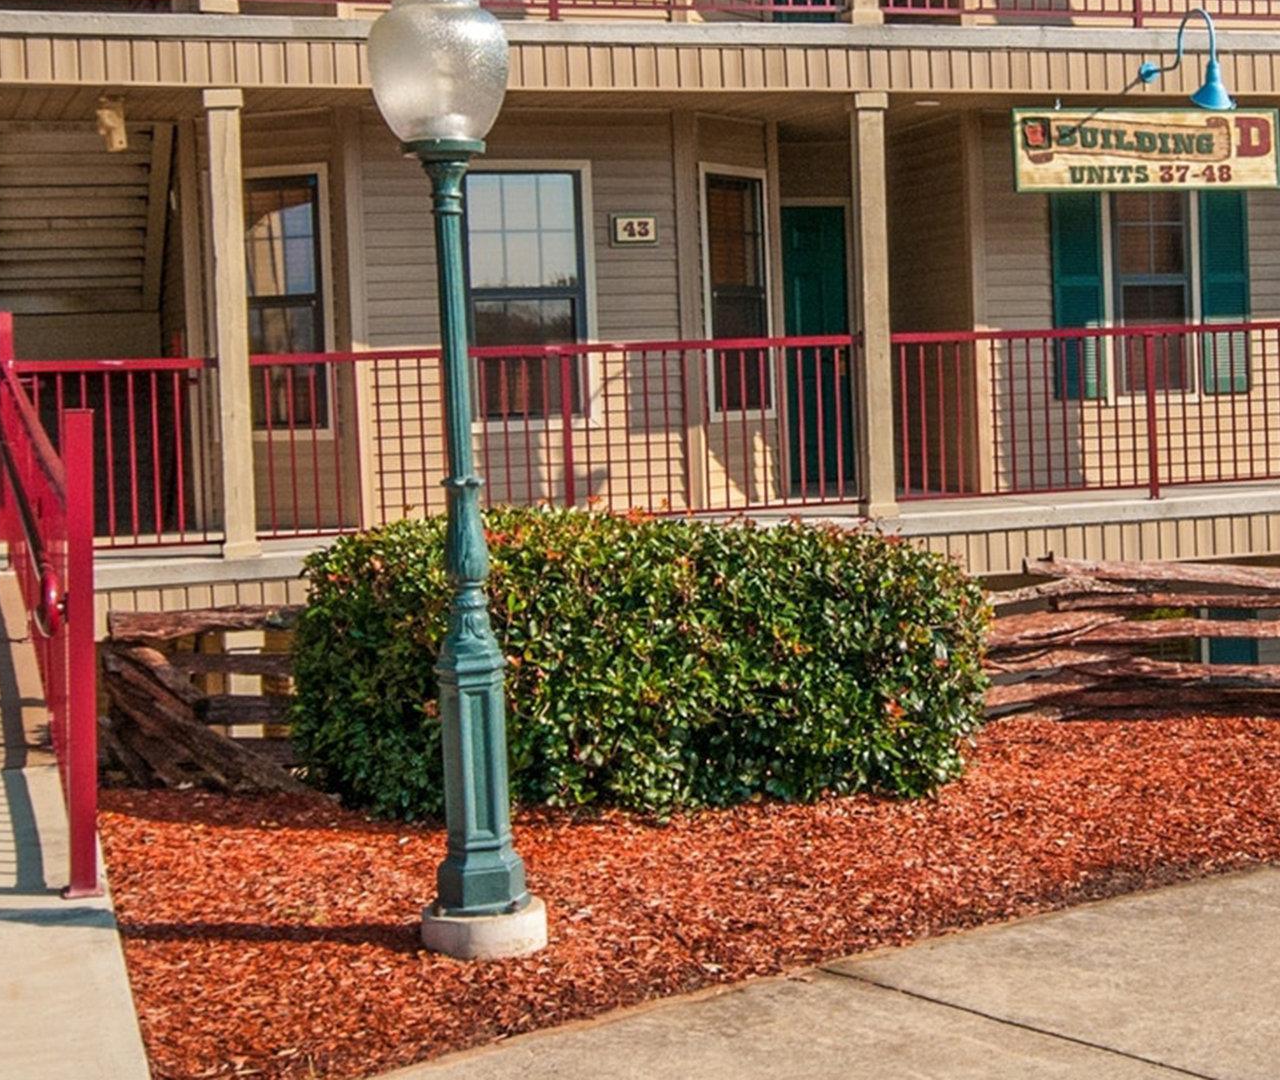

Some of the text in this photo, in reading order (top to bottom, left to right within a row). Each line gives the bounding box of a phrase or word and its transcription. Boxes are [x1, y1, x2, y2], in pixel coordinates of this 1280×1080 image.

[1055, 116, 1271, 157] BUILDING D
[1068, 164, 1233, 184] UNITS 37-48
[623, 221, 650, 238] 43
